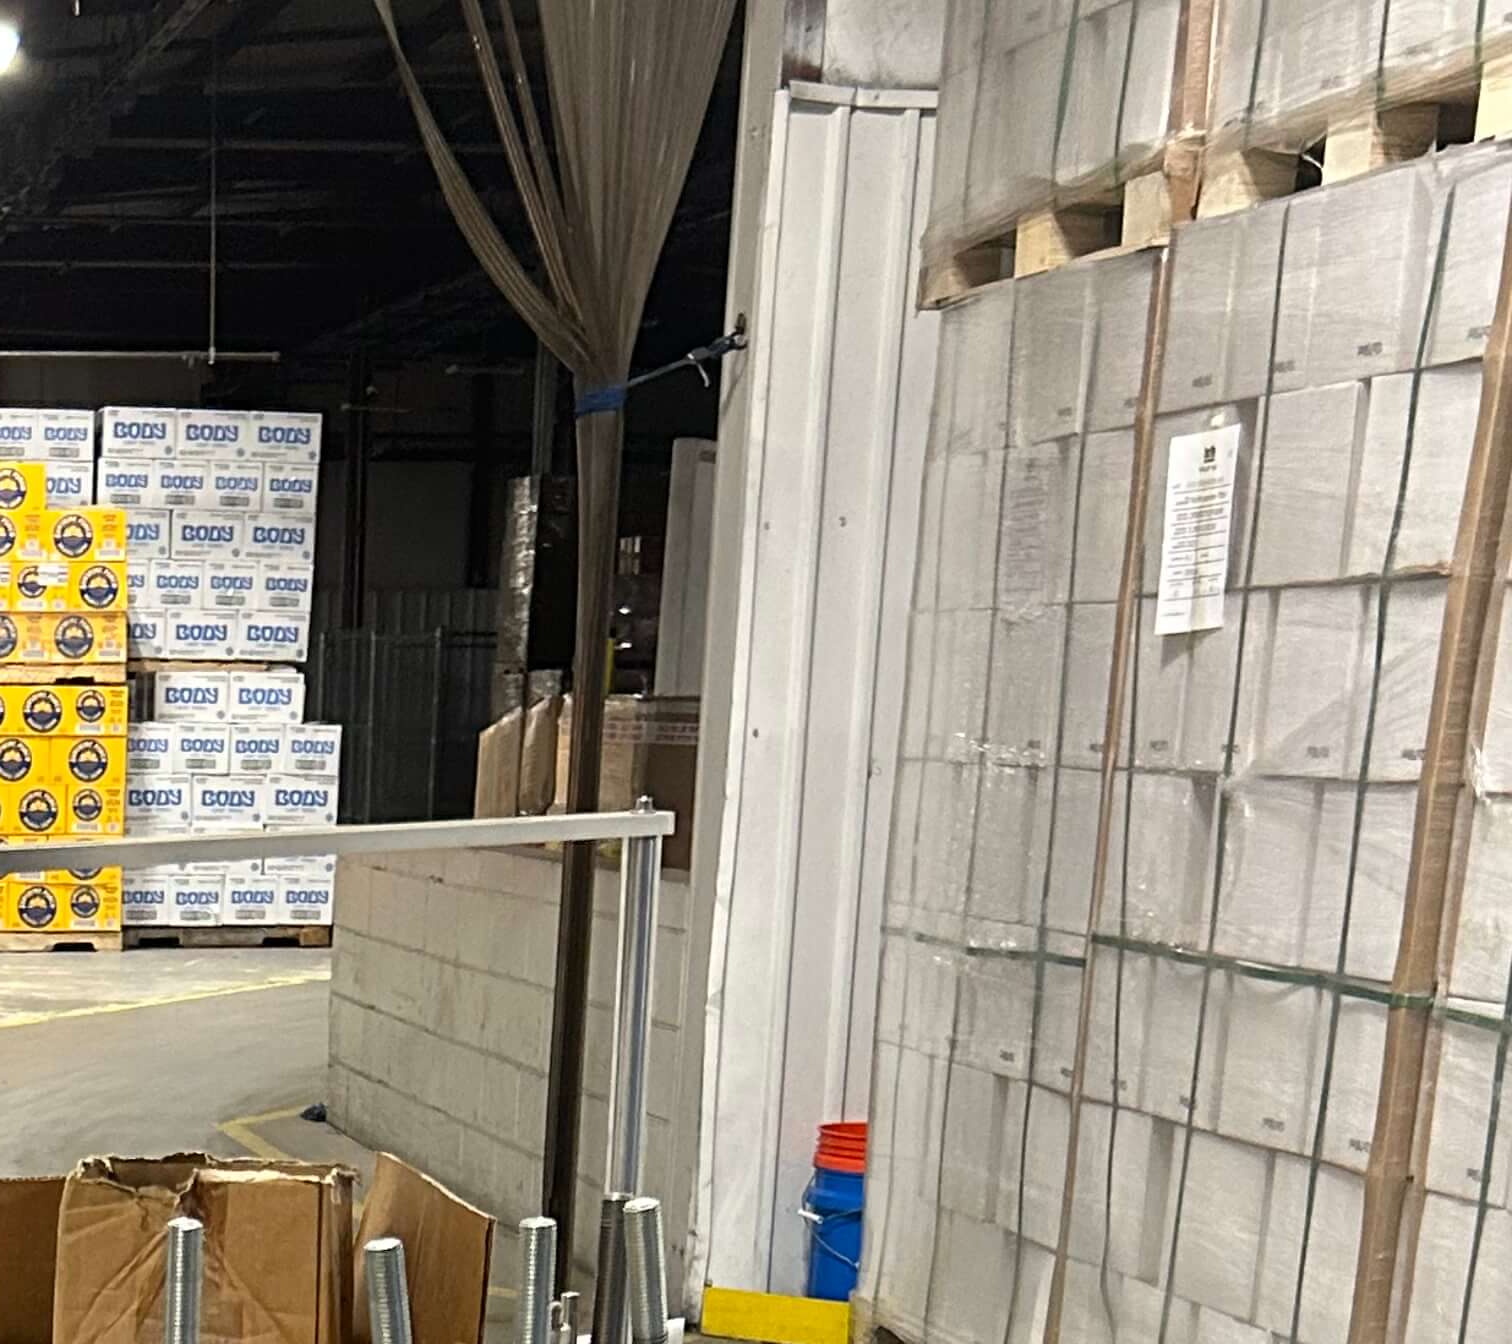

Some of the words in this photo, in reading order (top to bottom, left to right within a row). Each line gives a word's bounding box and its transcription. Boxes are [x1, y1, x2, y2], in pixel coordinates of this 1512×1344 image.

[45, 427, 87, 442] BODY
[114, 423, 166, 439] BODY
[187, 426, 238, 442] BODY
[259, 428, 310, 444] BODY
[47, 478, 81, 494] ODY
[106, 473, 147, 488] BODY
[161, 475, 203, 490] BODY
[215, 476, 258, 491] BODY
[270, 479, 313, 494] BODY
[182, 527, 233, 543] BODY
[253, 528, 305, 544] BODY
[156, 575, 199, 590] BODY
[212, 576, 252, 591] BODY
[266, 578, 307, 593] BODY
[132, 624, 156, 639] DY
[176, 625, 227, 641] BODY
[247, 626, 299, 642] BODY
[165, 688, 218, 704] BODY
[238, 688, 291, 704] BODY
[182, 739, 224, 754] BODY
[235, 739, 279, 754] BODY
[292, 740, 334, 755] BODY
[128, 789, 181, 805] BODY
[202, 791, 254, 807] BODY
[276, 790, 328, 806] BODY
[175, 891, 219, 906] BODY
[232, 890, 274, 905] BODY
[286, 890, 328, 905] BODY
